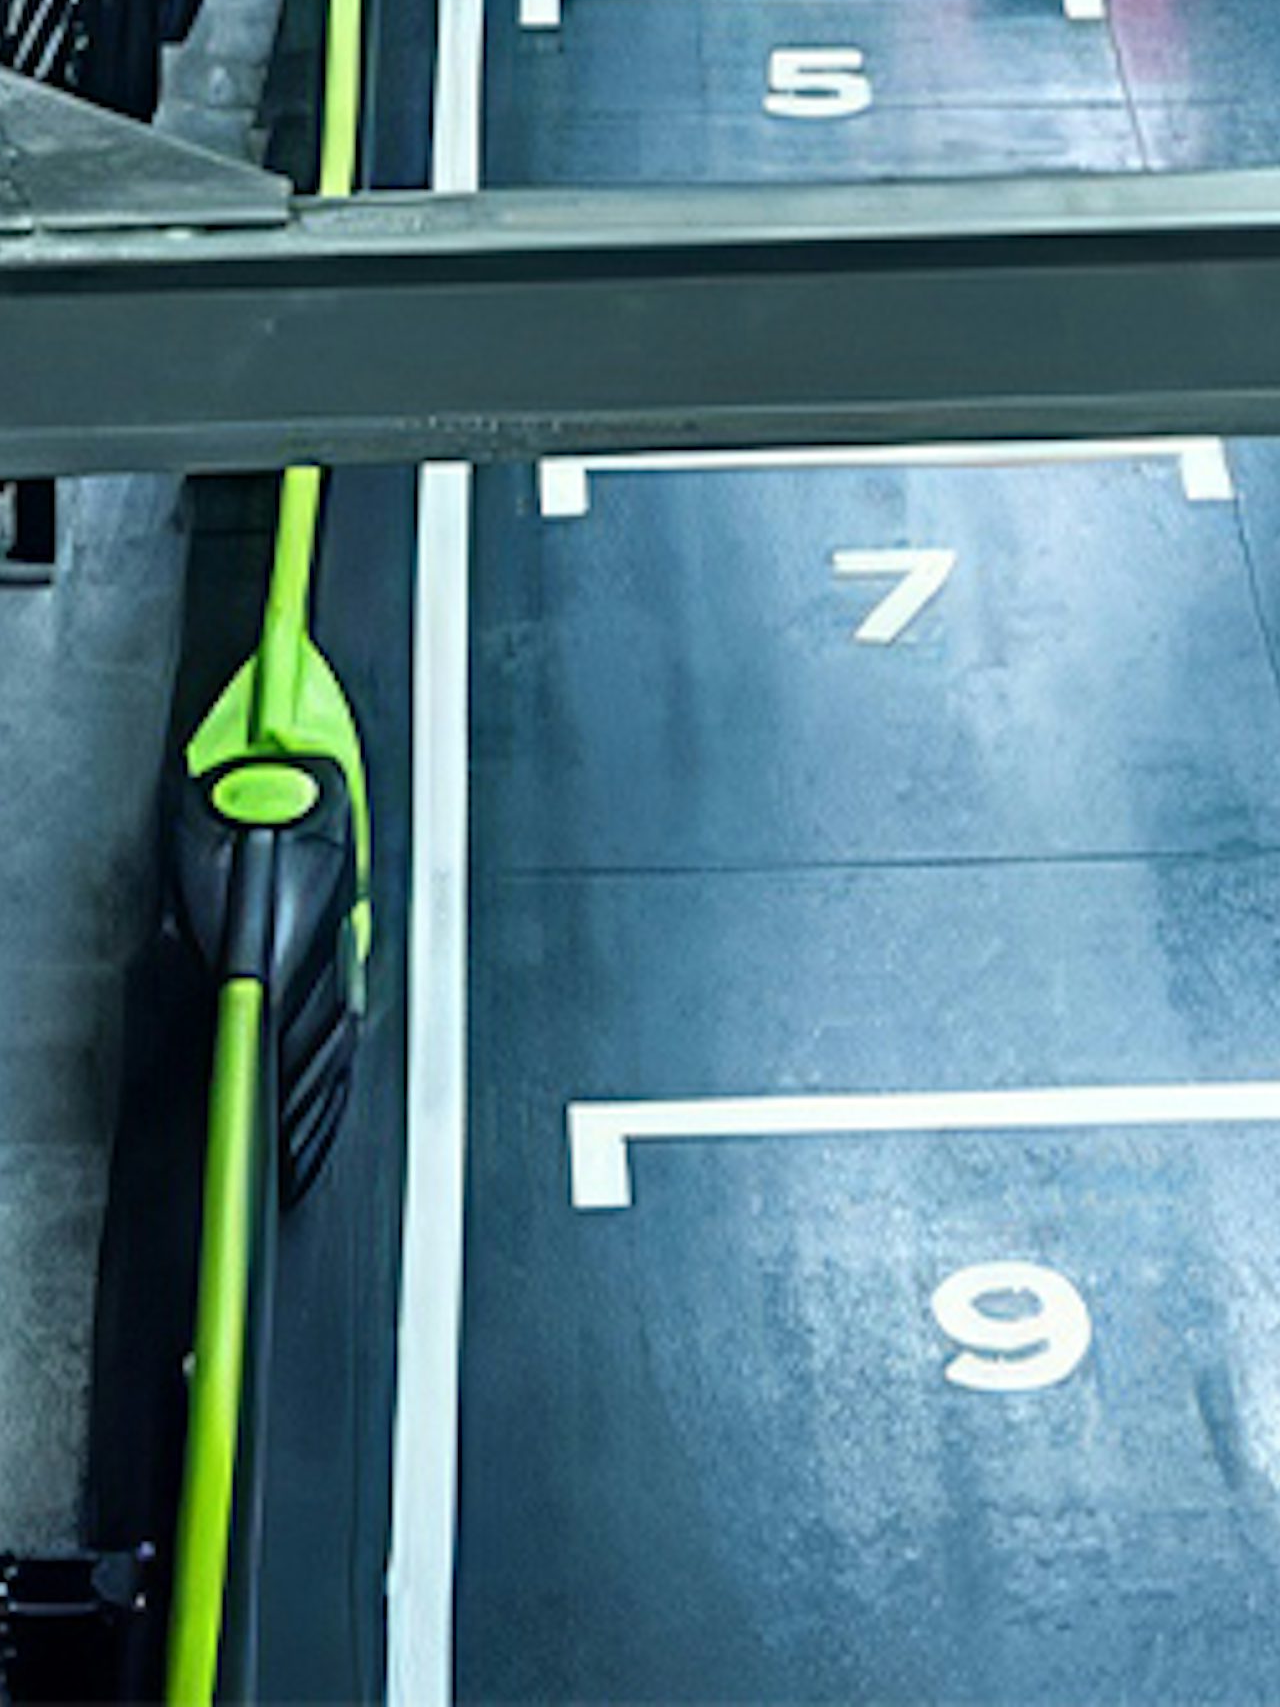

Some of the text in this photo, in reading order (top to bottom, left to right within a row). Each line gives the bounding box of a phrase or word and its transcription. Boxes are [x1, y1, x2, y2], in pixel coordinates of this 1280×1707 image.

[764, 50, 872, 117] 5
[834, 548, 958, 642] 7
[931, 1260, 1091, 1390] 9
